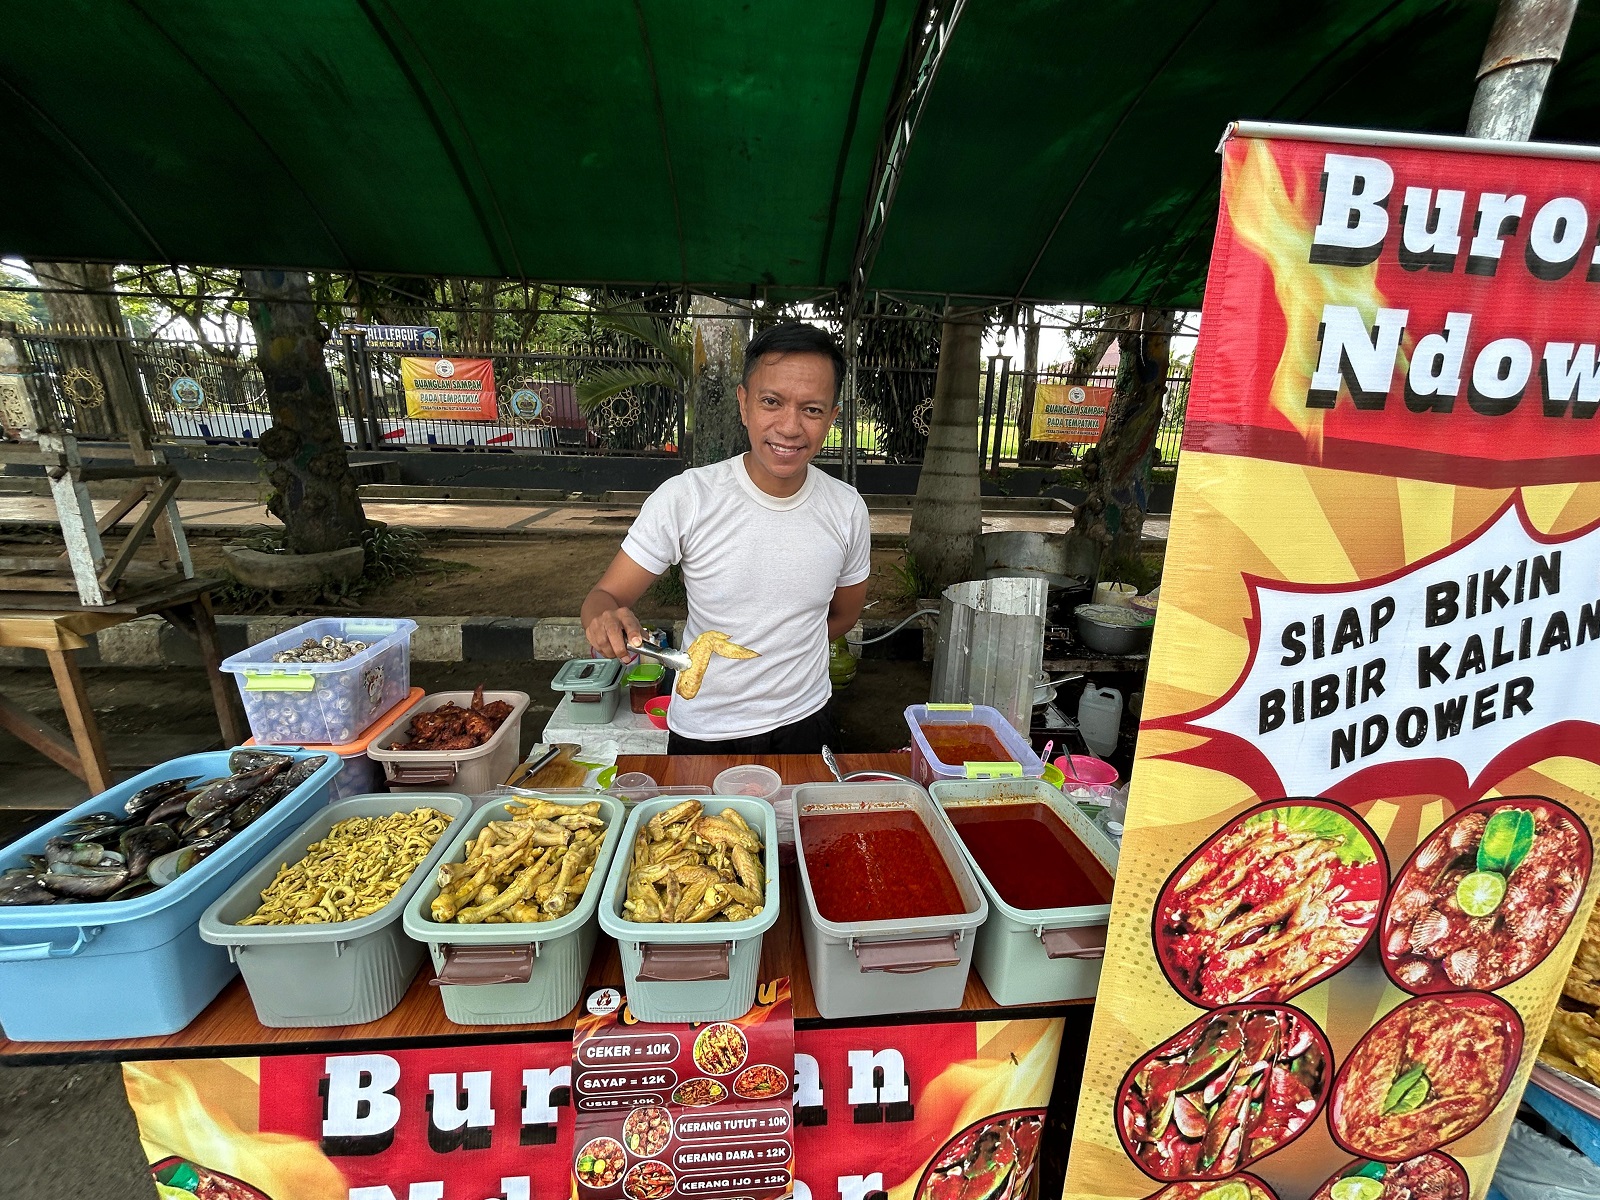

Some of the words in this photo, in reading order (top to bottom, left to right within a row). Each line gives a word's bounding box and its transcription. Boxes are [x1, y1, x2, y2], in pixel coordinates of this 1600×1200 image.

[1309, 152, 1600, 276] Buro
[386, 328, 419, 341] LEAGUE
[414, 379, 451, 390] BUANGLAH
[452, 380, 482, 391] SAMPAH
[420, 393, 437, 403] PADA
[439, 393, 480, 404] TEMPATNYA
[1045, 404, 1078, 415] BUANGLAH
[1079, 405, 1105, 416] SAMPAH
[1047, 417, 1063, 428] PADA
[1065, 418, 1099, 429] TEMPATNYA
[1280, 596, 1396, 667] SIAP
[1425, 550, 1562, 628] BIKIN
[1258, 657, 1387, 735] BIBIR
[1418, 599, 1600, 689] KALIAN
[1330, 676, 1535, 770] NDOWER
[586, 1046, 631, 1058] CEKER
[646, 1043, 671, 1055] 10K
[583, 1078, 627, 1089] SAYAP
[641, 1075, 666, 1085] 12K
[679, 1121, 722, 1133] KERANG
[723, 1119, 757, 1130] TUTUT
[768, 1116, 787, 1127] 10K
[678, 1151, 723, 1164] KERANG
[725, 1149, 754, 1160] DARA
[766, 1147, 786, 1157] 12K
[682, 1180, 730, 1190] KERANG
[733, 1178, 751, 1187] IJO
[764, 1174, 786, 1184] 12K
